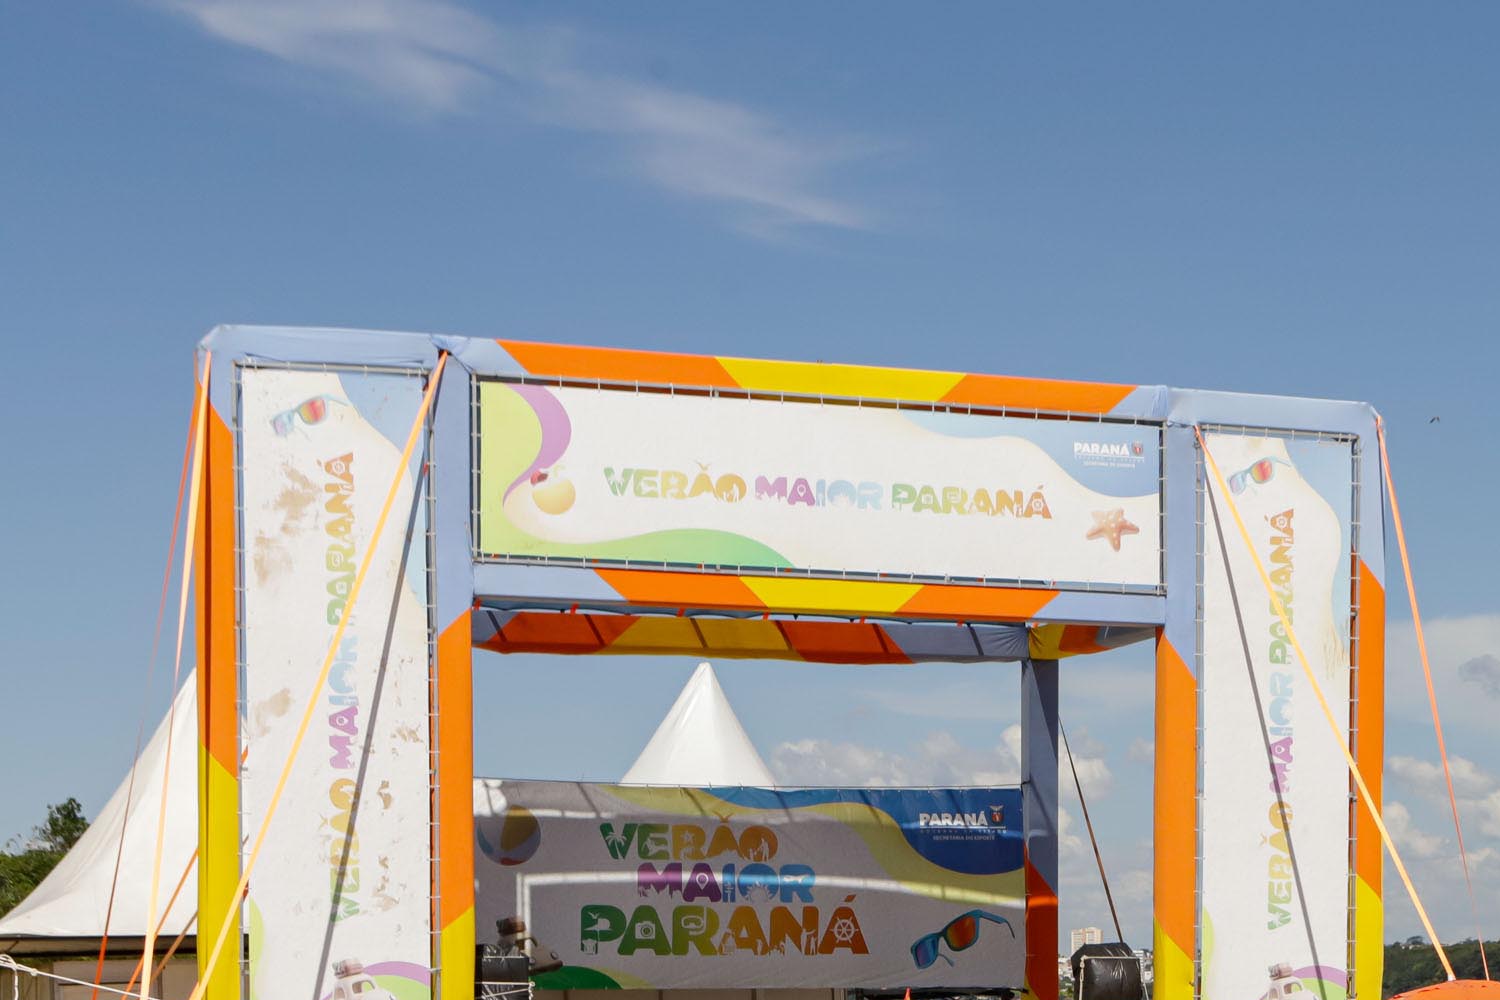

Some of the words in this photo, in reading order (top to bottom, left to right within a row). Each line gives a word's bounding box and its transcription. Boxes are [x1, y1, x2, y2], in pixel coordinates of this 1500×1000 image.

[1074, 442, 1130, 455] PARANÁ
[603, 458, 747, 503] VERÃO
[754, 475, 884, 510] MAIOR
[891, 483, 1053, 520] PARANÁ
[1264, 508, 1294, 665] PARANÁ
[1268, 672, 1294, 794] MAIOR
[599, 810, 778, 862] VERÃO
[919, 811, 988, 826] PARANÁ
[637, 862, 816, 904] MAIOR
[580, 894, 870, 956] PARANÁ
